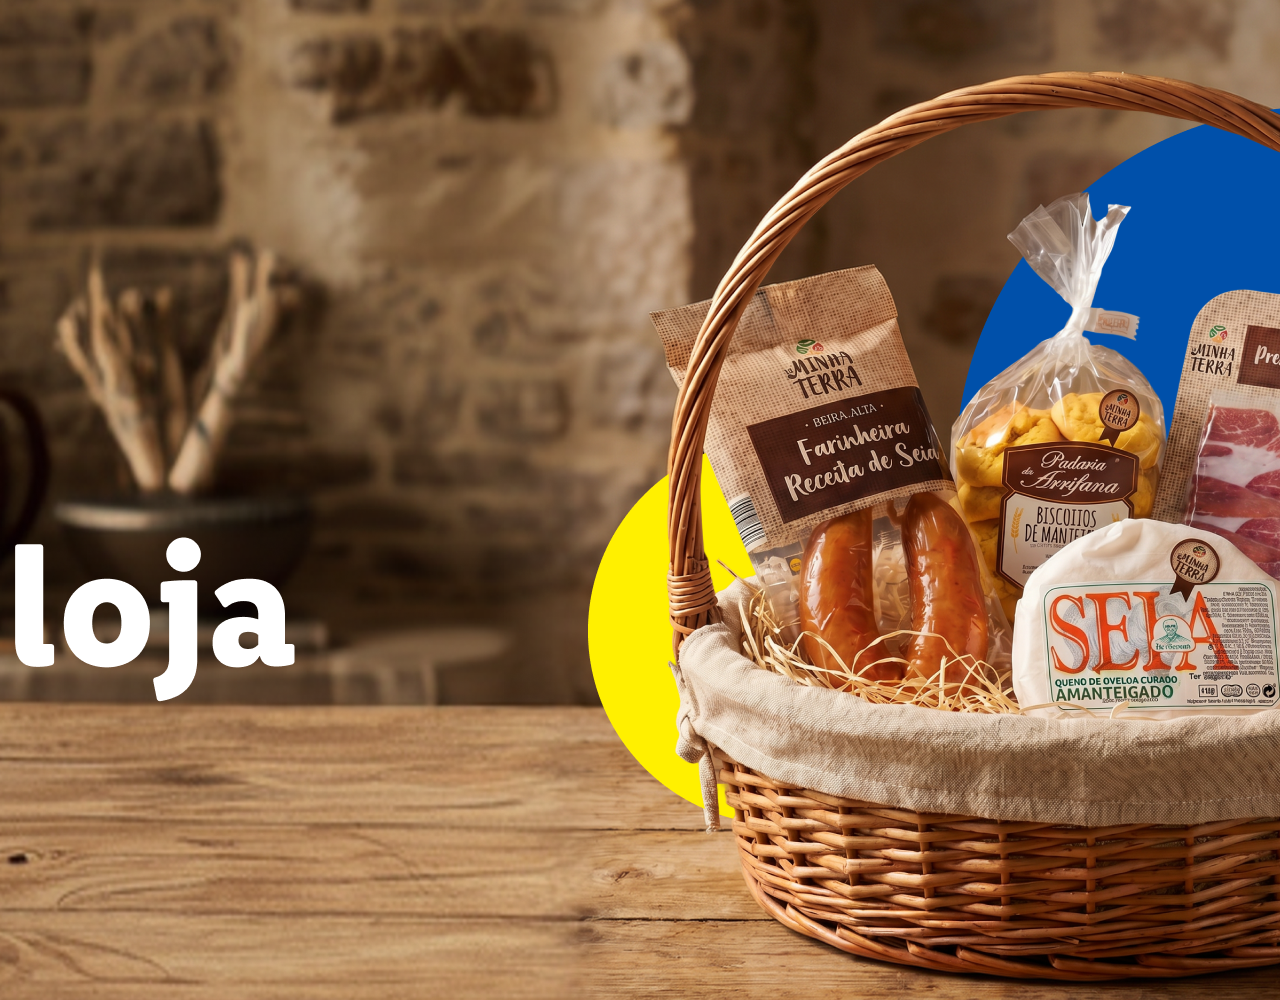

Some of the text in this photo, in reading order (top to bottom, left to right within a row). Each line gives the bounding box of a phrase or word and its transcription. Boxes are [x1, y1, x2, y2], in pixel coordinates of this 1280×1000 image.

[1191, 343, 1235, 362] MINHA
[787, 350, 854, 380] MINHA
[1191, 356, 1233, 377] TERRA
[792, 365, 863, 399] TERRA
[1104, 411, 1129, 428] TERRA
[796, 421, 910, 466] Farinheira
[784, 442, 940, 502] Receita de Seia
[1040, 450, 1107, 472] Padaria
[1019, 470, 1120, 497] Arrifana
[1024, 523, 1038, 543] DE
[1174, 560, 1206, 582] TERRA
[1048, 590, 1240, 675] SEIA
[1089, 677, 1101, 686] DE
[1056, 685, 1174, 701] AMANTEIGADO
